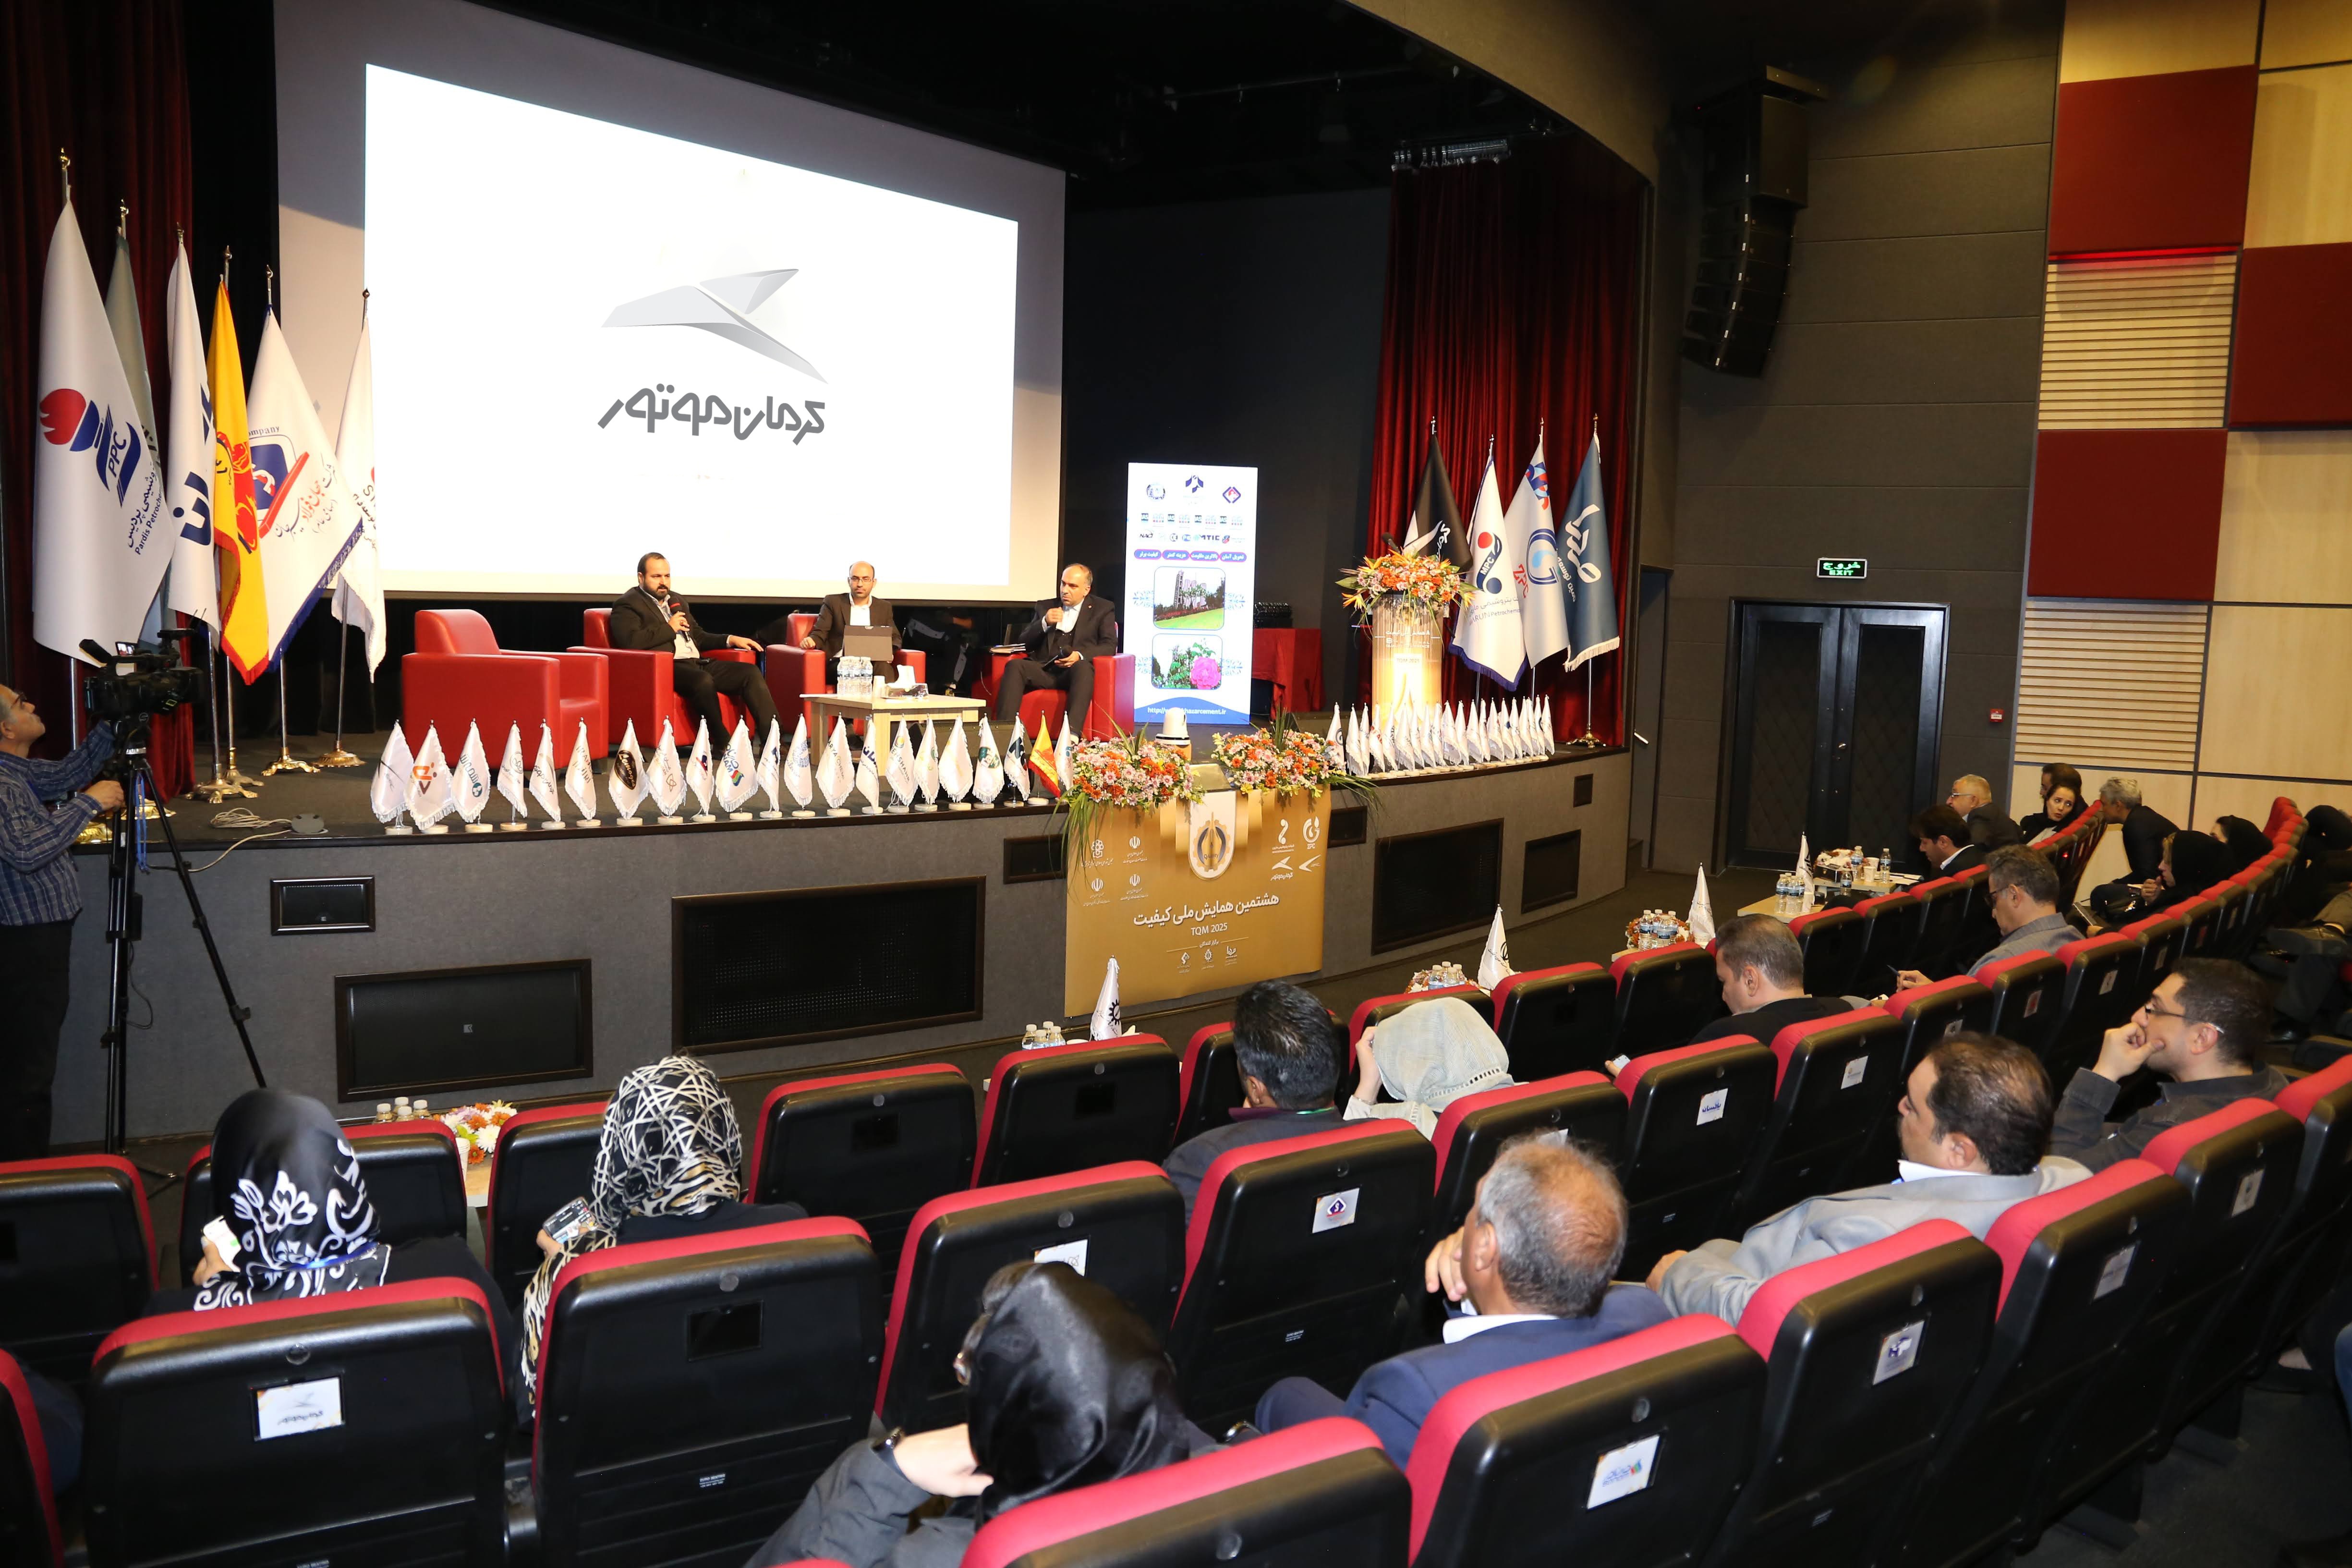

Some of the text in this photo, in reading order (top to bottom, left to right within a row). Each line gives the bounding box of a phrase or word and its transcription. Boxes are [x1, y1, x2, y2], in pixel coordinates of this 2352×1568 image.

[597, 383, 825, 446] کرمان موتور
[249, 426, 279, 436] ompany
[108, 431, 126, 478] PPC
[129, 509, 145, 548] پردیس
[134, 528, 150, 555] Pardis
[1480, 557, 1494, 575] MPC
[1823, 561, 1861, 570] خروج
[1513, 564, 1528, 598] ZPC
[1133, 893, 1280, 928] هشتمین همایش ملی کیفیت
[1191, 923, 1228, 936] TQM 2025
